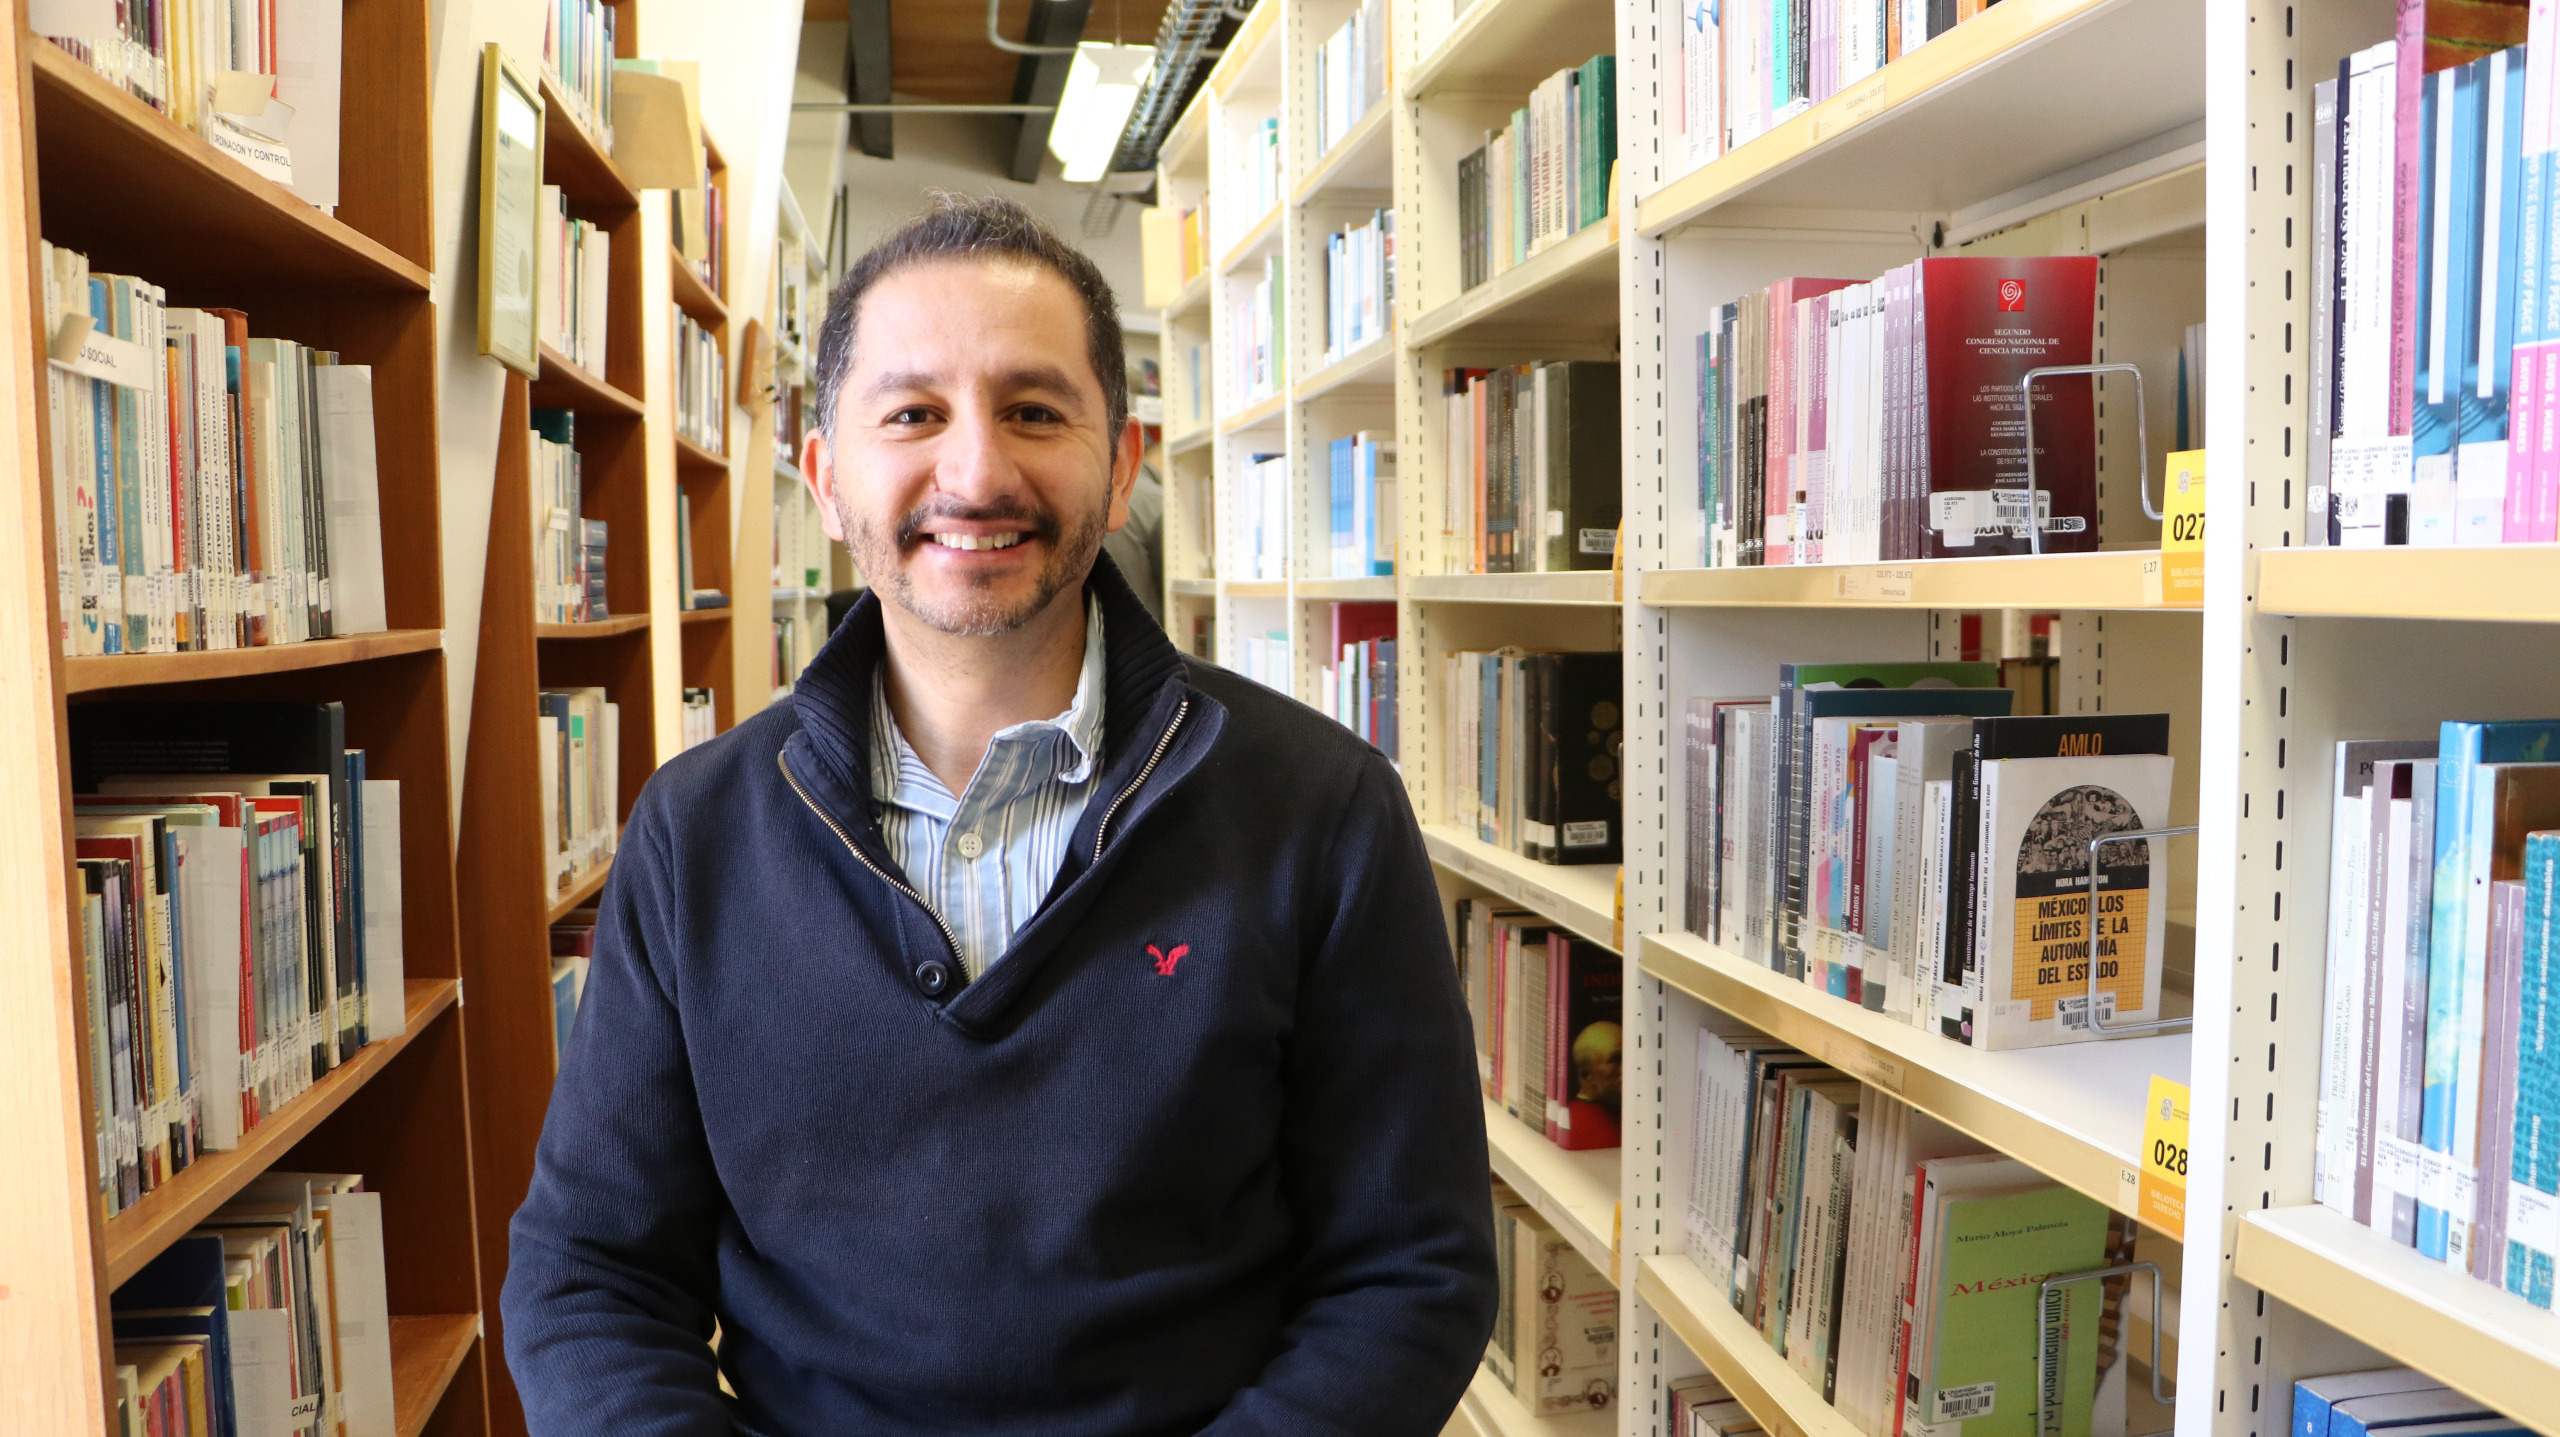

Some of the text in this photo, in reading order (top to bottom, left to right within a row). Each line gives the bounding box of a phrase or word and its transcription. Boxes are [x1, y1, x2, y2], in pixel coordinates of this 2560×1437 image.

[254, 149, 291, 167] CONTROL
[2341, 113, 2351, 202] POPULISTA
[2520, 178, 2538, 335] THE ILLUSION OF PEACE
[2548, 265, 2559, 283] OF
[2339, 281, 2348, 300] EL
[2547, 284, 2559, 331] PEACE
[1994, 328, 2031, 336] SEGUNDO
[2317, 316, 2325, 339] Latina
[87, 347, 117, 368] SOCIAL
[2011, 346, 2046, 354] POLÍTICA
[2316, 342, 2325, 374] América
[2316, 377, 2324, 387] en
[2315, 390, 2324, 424] gobierno
[2516, 356, 2530, 454] DAVID R. MARES
[2541, 354, 2557, 452] DAVID R. MARES
[211, 386, 219, 466] SOCIOLOGY
[215, 496, 223, 573] GLOBALIZA
[2173, 513, 2206, 541] 027
[2144, 561, 2157, 573] E.27
[2170, 567, 2204, 577] BIBLIOTECA
[2173, 579, 2203, 588] DERECHO
[2057, 733, 2102, 757] AMLO
[1822, 773, 1828, 786] en
[334, 847, 342, 922] VIOLENCIA
[2055, 877, 2073, 888] NORA
[2099, 894, 2124, 913] LOS
[2032, 919, 2081, 942] LÍMITES
[2112, 916, 2129, 934] LA
[2535, 859, 2554, 1052] Visiones de sociedades deseables
[2038, 967, 2061, 985] DEL
[2367, 1007, 2375, 1018] en
[2364, 1021, 2374, 1070] Centralismo
[2364, 1073, 2372, 1085] del
[2360, 1088, 2371, 1155] Establecimiento
[2154, 1138, 2188, 1176] 028
[2121, 1169, 2135, 1184] E.28
[2150, 1188, 2184, 1210] BIBLIOTECA
[2153, 1200, 2181, 1219] DERECHO
[1956, 1221, 2069, 1243] Mario Moya Palencia
[291, 1402, 316, 1417] CIAL
[2306, 1421, 2313, 1433] 8
